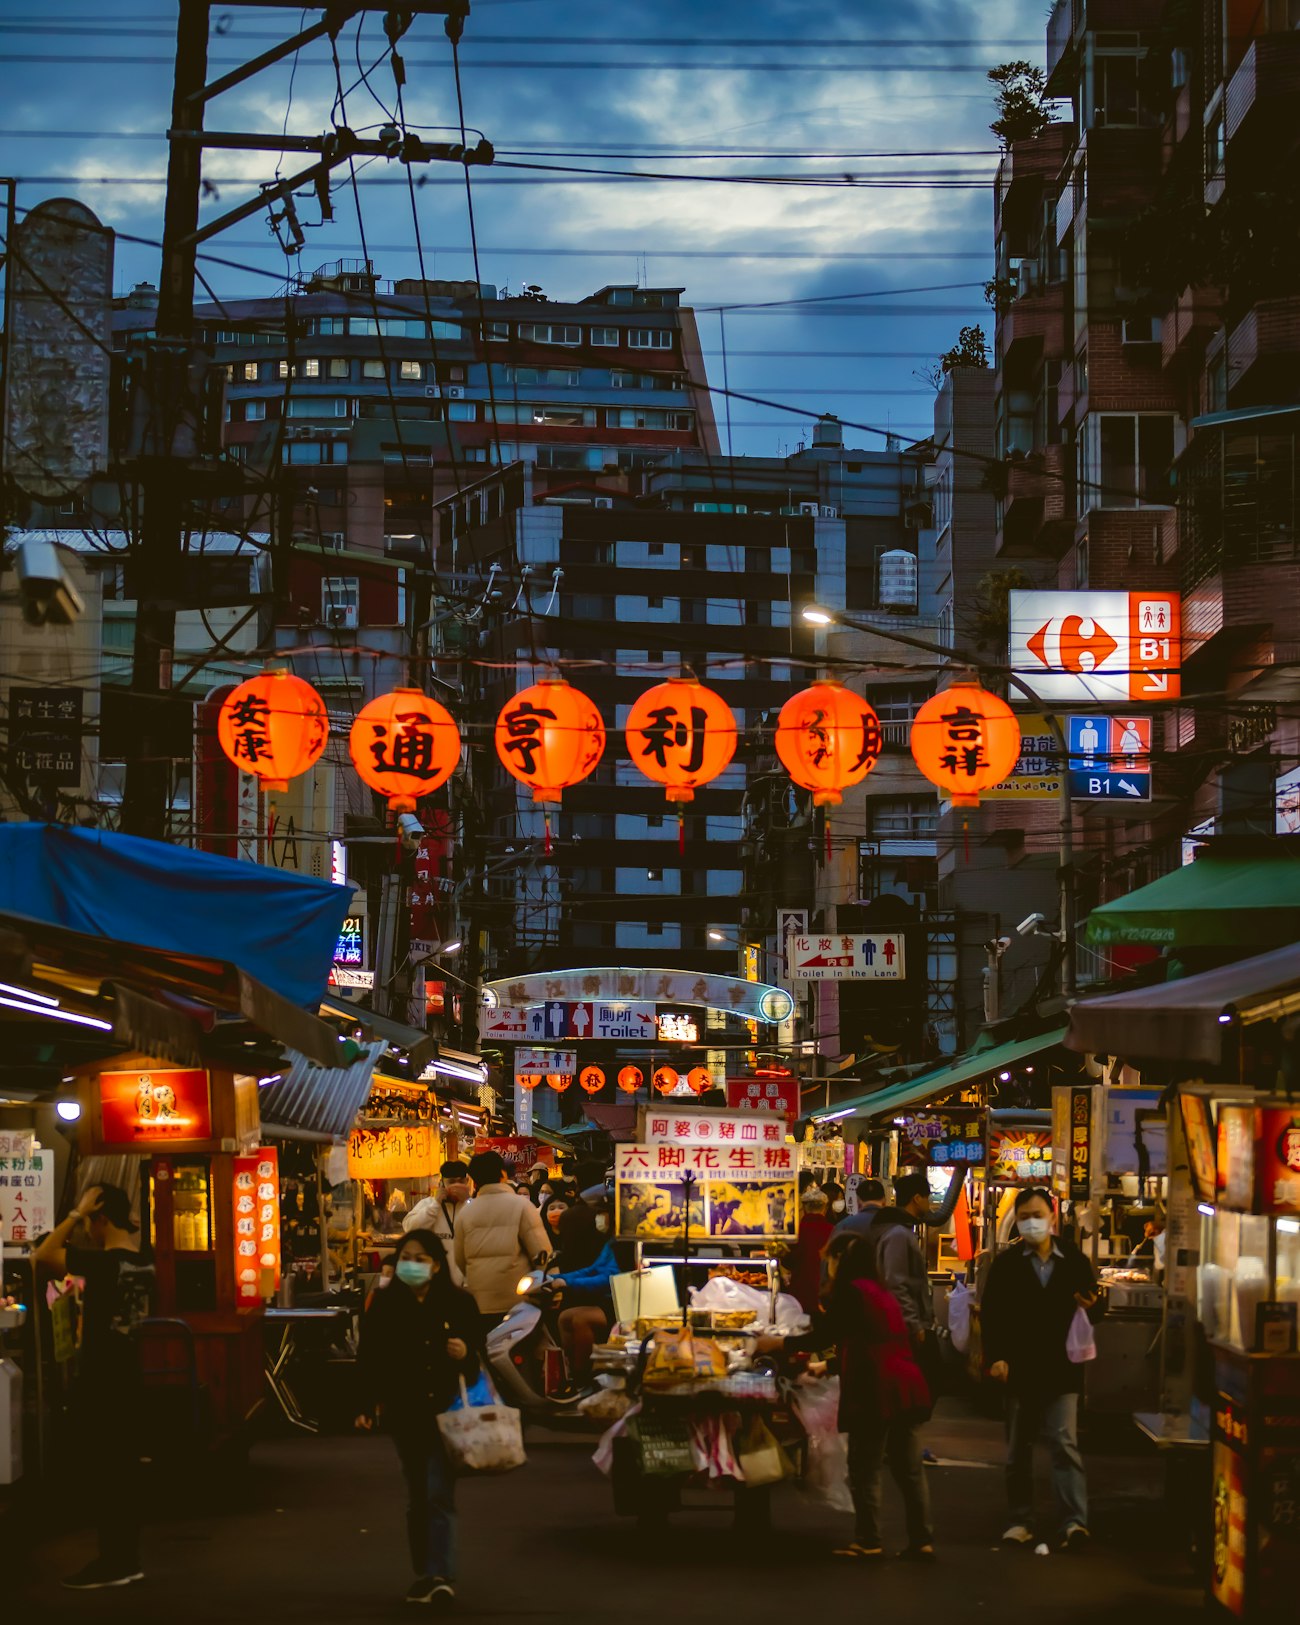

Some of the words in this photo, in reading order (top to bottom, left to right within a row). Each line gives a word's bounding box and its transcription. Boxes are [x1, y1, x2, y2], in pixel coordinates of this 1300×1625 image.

[1139, 638, 1170, 661] B1
[228, 694, 273, 762] 安康
[370, 712, 442, 780] 通
[504, 702, 557, 775] 亨
[640, 706, 708, 772] 利
[939, 706, 990, 776] 吉祥
[1089, 778, 1111, 794] B1
[796, 969, 824, 978] Toilet
[851, 969, 866, 978] the
[874, 969, 898, 978] Lane
[599, 1025, 648, 1038] Toilet
